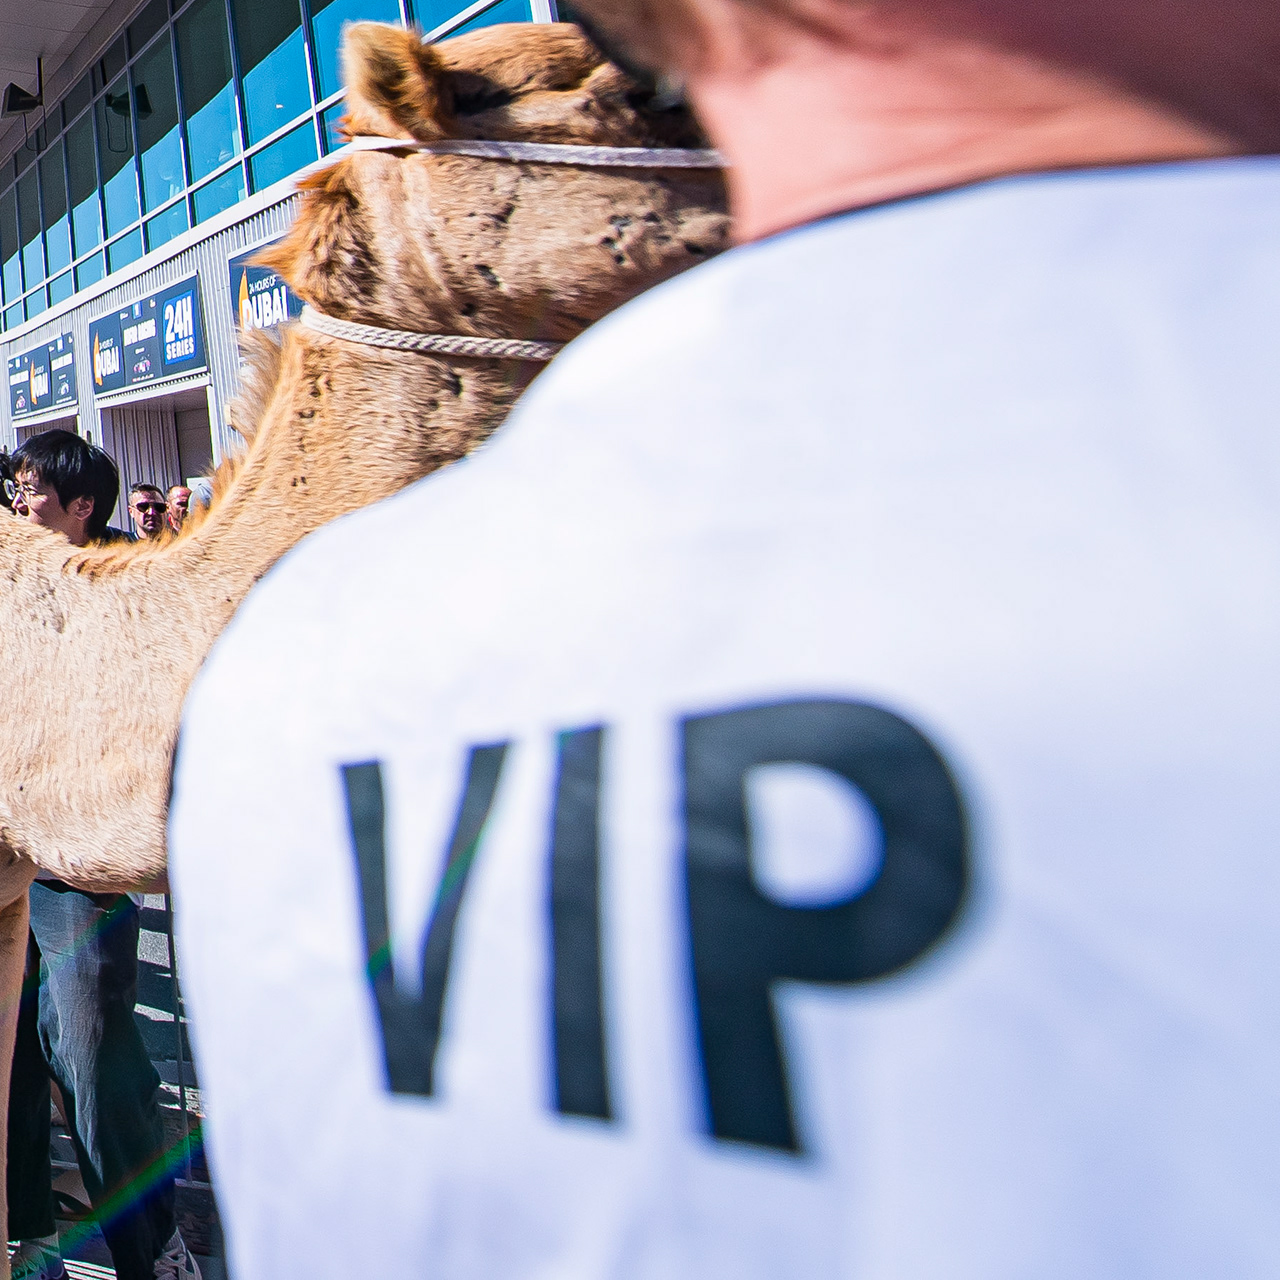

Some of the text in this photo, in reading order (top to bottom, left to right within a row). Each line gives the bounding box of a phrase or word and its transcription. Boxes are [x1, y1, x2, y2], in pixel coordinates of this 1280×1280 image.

[254, 277, 270, 292] HOURS
[270, 274, 277, 287] OF
[164, 296, 194, 344] 24H
[242, 285, 289, 331] DUBAI
[95, 345, 120, 378] DUBAI
[166, 337, 195, 361] SERIES
[338, 696, 977, 1158] VIP
